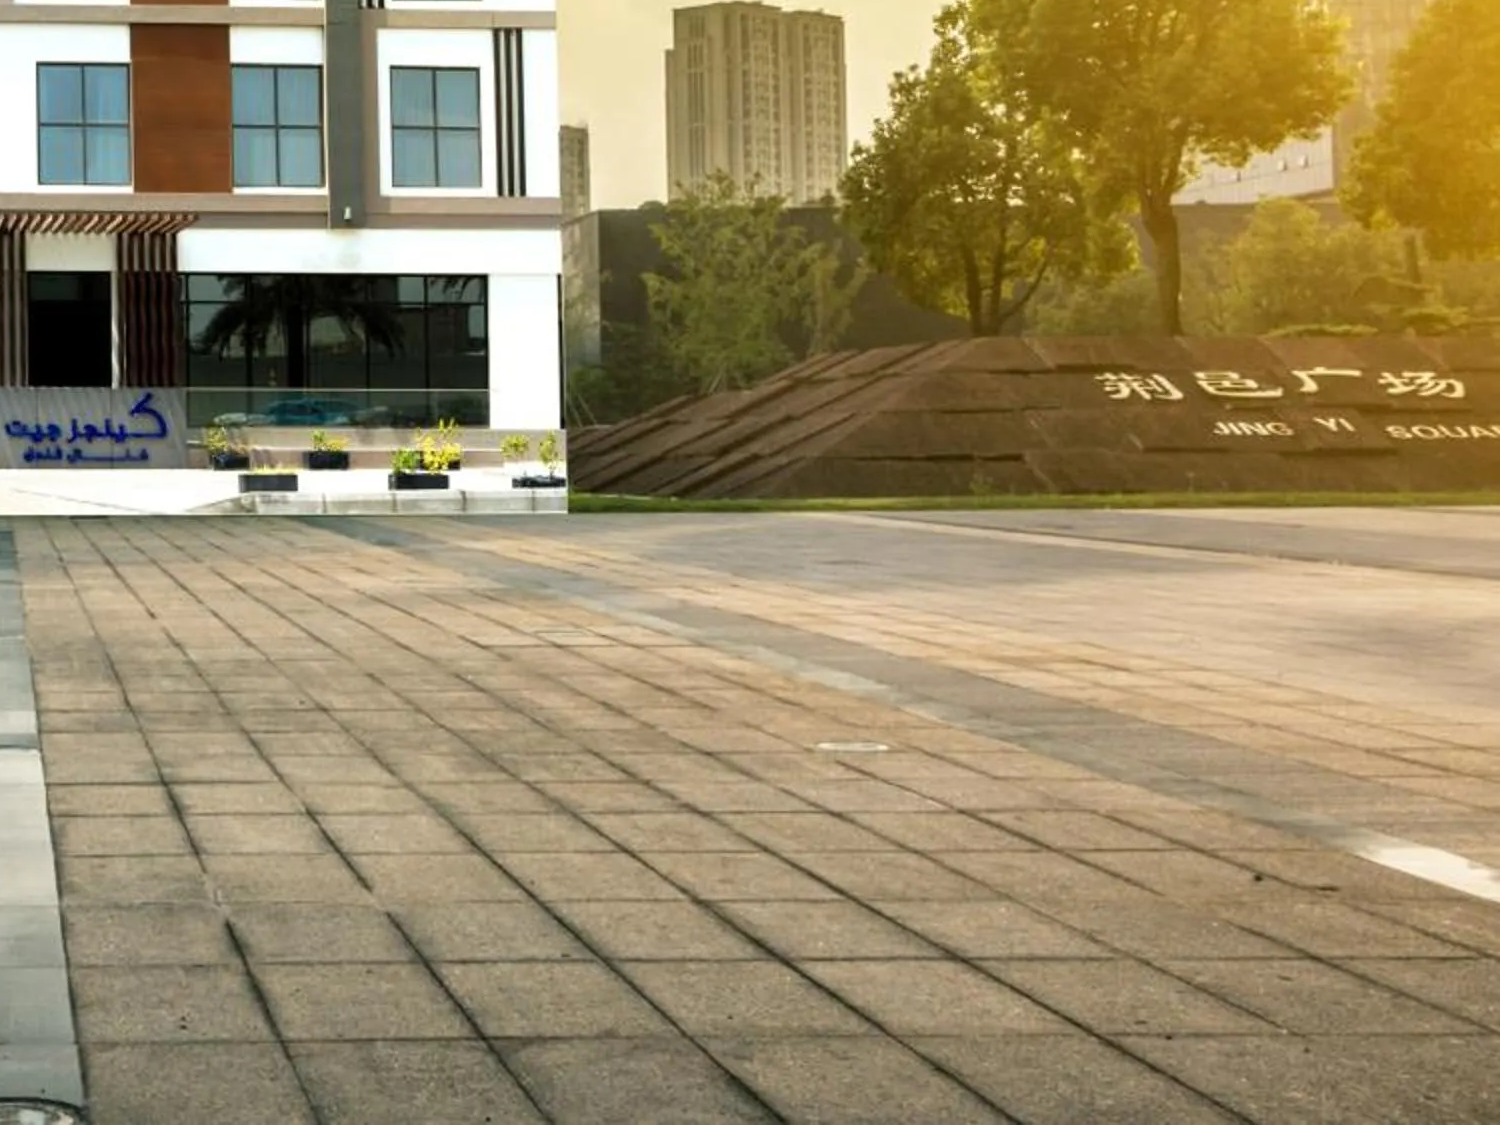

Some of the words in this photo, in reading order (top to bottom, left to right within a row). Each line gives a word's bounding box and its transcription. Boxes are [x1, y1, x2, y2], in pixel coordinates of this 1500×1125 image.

[1095, 366, 1467, 401] 荆邑广场
[1213, 421, 1294, 437] JING
[1313, 417, 1356, 433] YI
